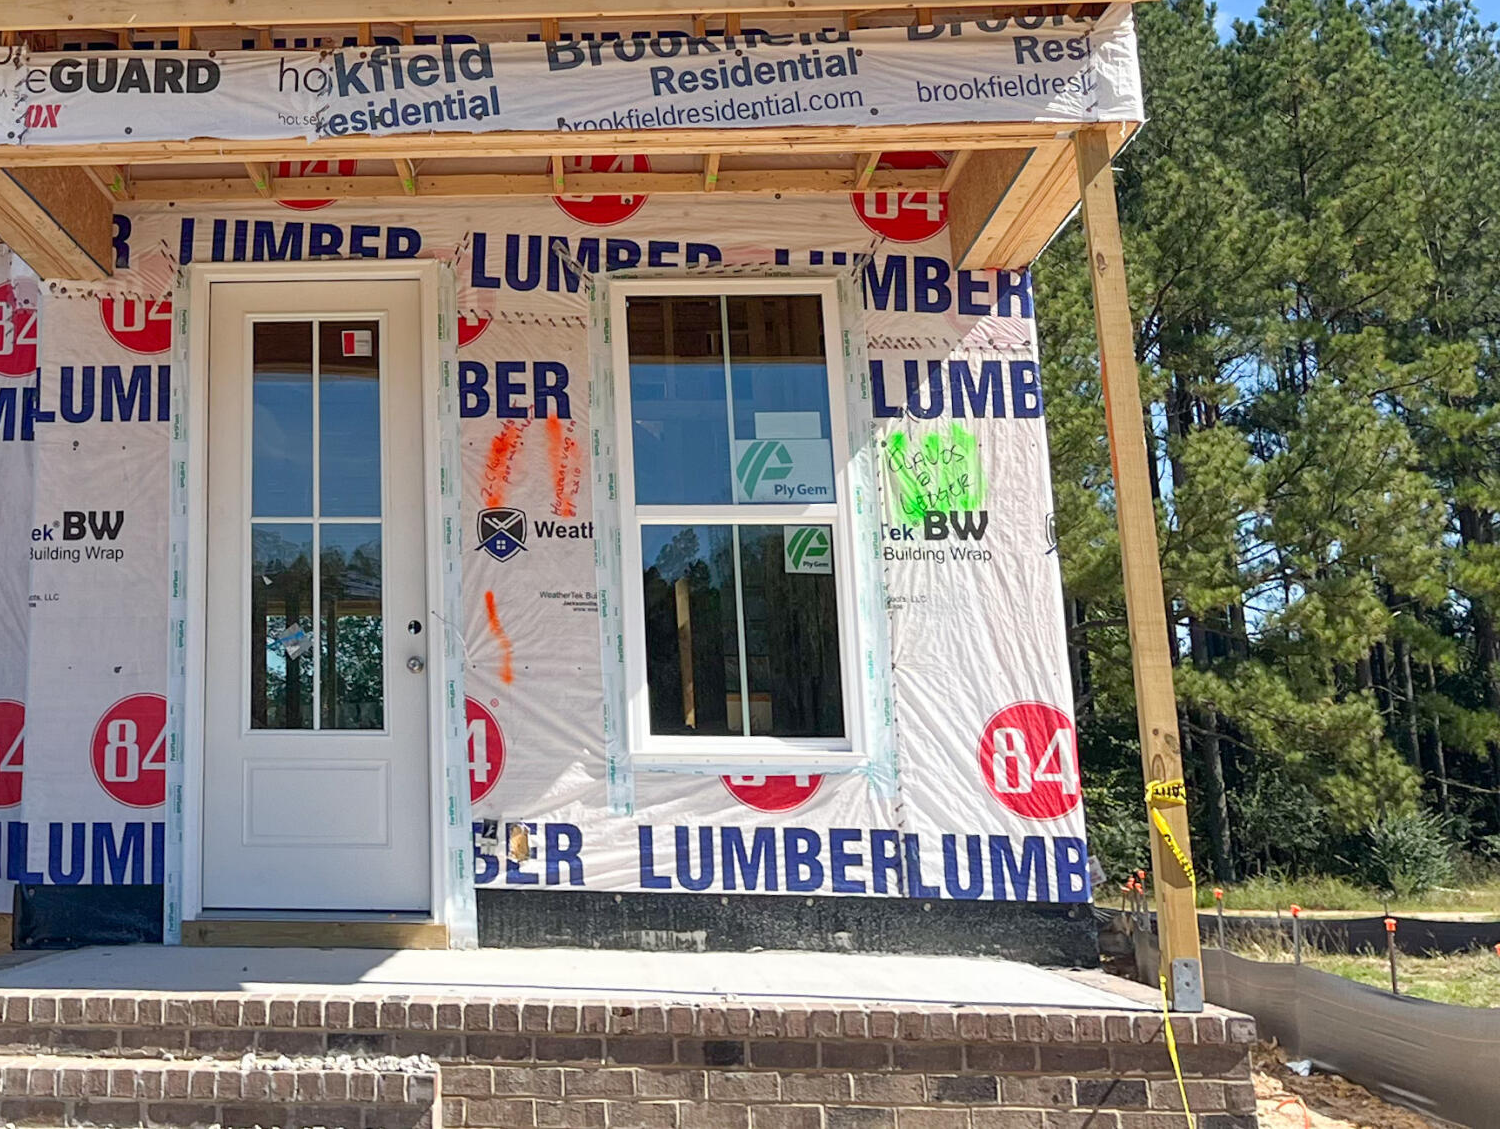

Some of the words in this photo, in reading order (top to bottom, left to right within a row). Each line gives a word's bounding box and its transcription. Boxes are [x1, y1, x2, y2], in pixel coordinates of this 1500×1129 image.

[651, 47, 858, 96] Residential
[24, 104, 62, 128] OX
[325, 85, 501, 136] esidential
[459, 361, 572, 419] BER
[869, 359, 1044, 419] LUMB
[62, 511, 124, 541] BW
[924, 511, 988, 540] BW
[85, 547, 124, 562] Wrap
[884, 547, 944, 564] Building
[950, 547, 992, 562] Wrap
[992, 726, 1078, 796] 84
[638, 824, 902, 895] LUMBER
